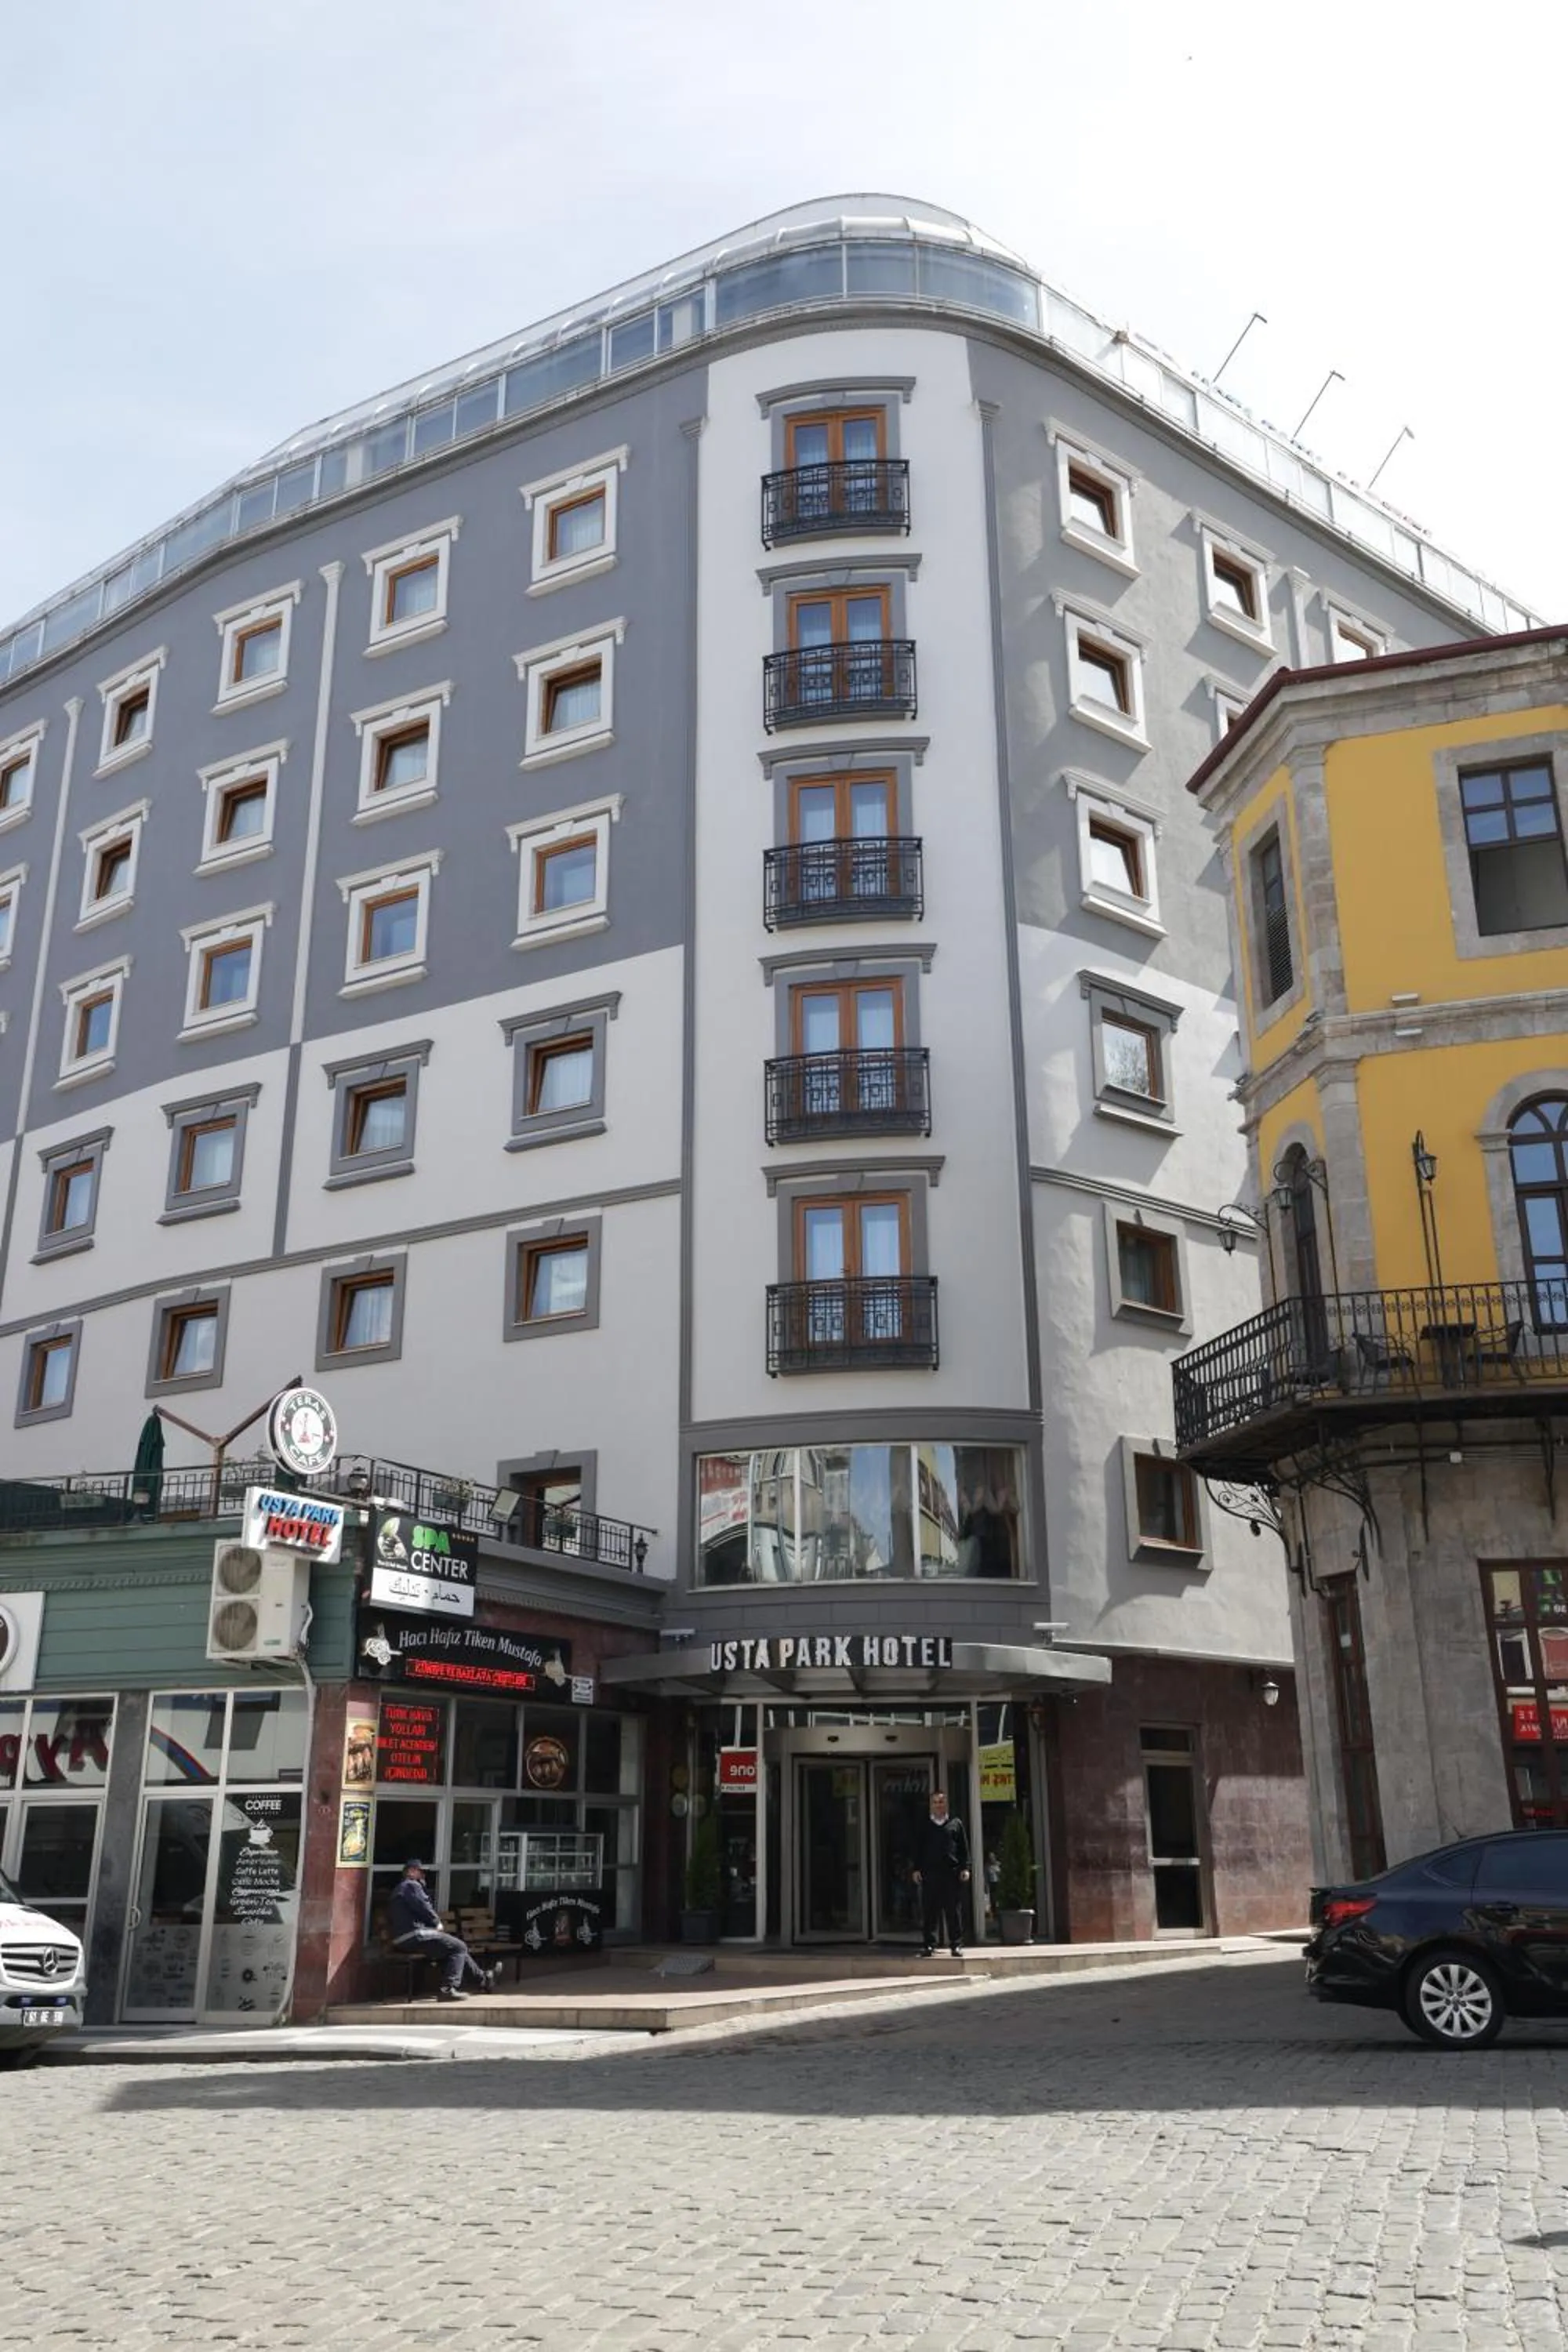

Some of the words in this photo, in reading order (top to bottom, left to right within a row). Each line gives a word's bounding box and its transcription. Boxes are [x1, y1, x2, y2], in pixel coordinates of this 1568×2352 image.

[290, 1396, 327, 1421] TERAS
[289, 1445, 325, 1466] CAFE
[258, 1494, 301, 1518] USTA
[300, 1503, 341, 1526] PARK
[265, 1515, 333, 1548] HOTEL
[412, 1525, 451, 1555] SPA
[410, 1551, 468, 1580] CENTER
[399, 1630, 427, 1648] Hacı
[464, 1631, 495, 1650] Tiken
[497, 1638, 543, 1668] Mustafa
[710, 1638, 770, 1671] USTA
[779, 1635, 852, 1668] PARK
[863, 1635, 952, 1668] HOTEL
[245, 1799, 282, 1810] COFFEE
